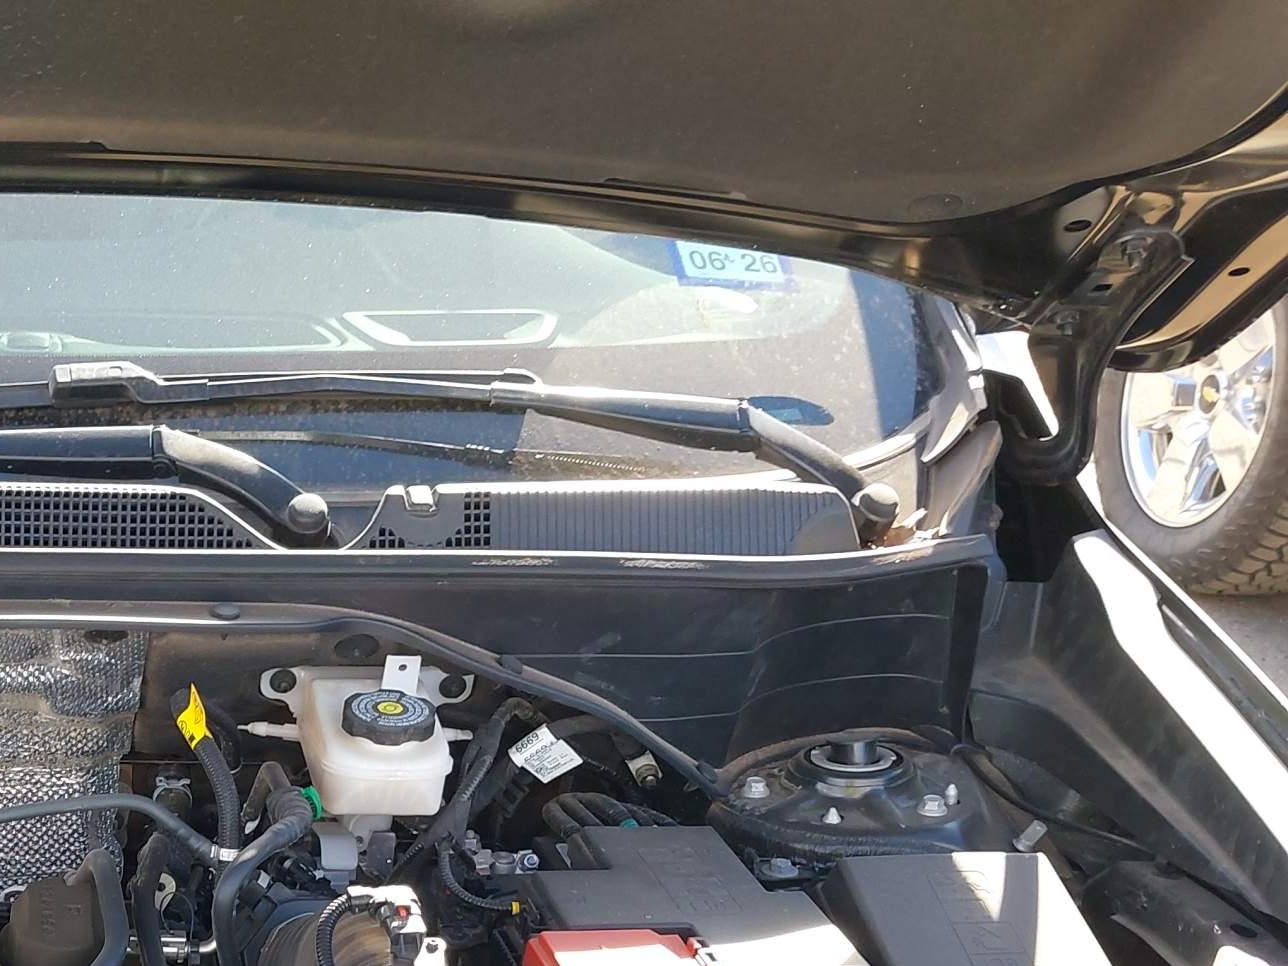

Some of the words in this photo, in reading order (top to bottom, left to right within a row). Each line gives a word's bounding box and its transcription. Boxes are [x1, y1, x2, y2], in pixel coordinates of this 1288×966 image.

[689, 250, 726, 271] 06
[740, 253, 778, 274] 26
[515, 731, 540, 753] 6669
